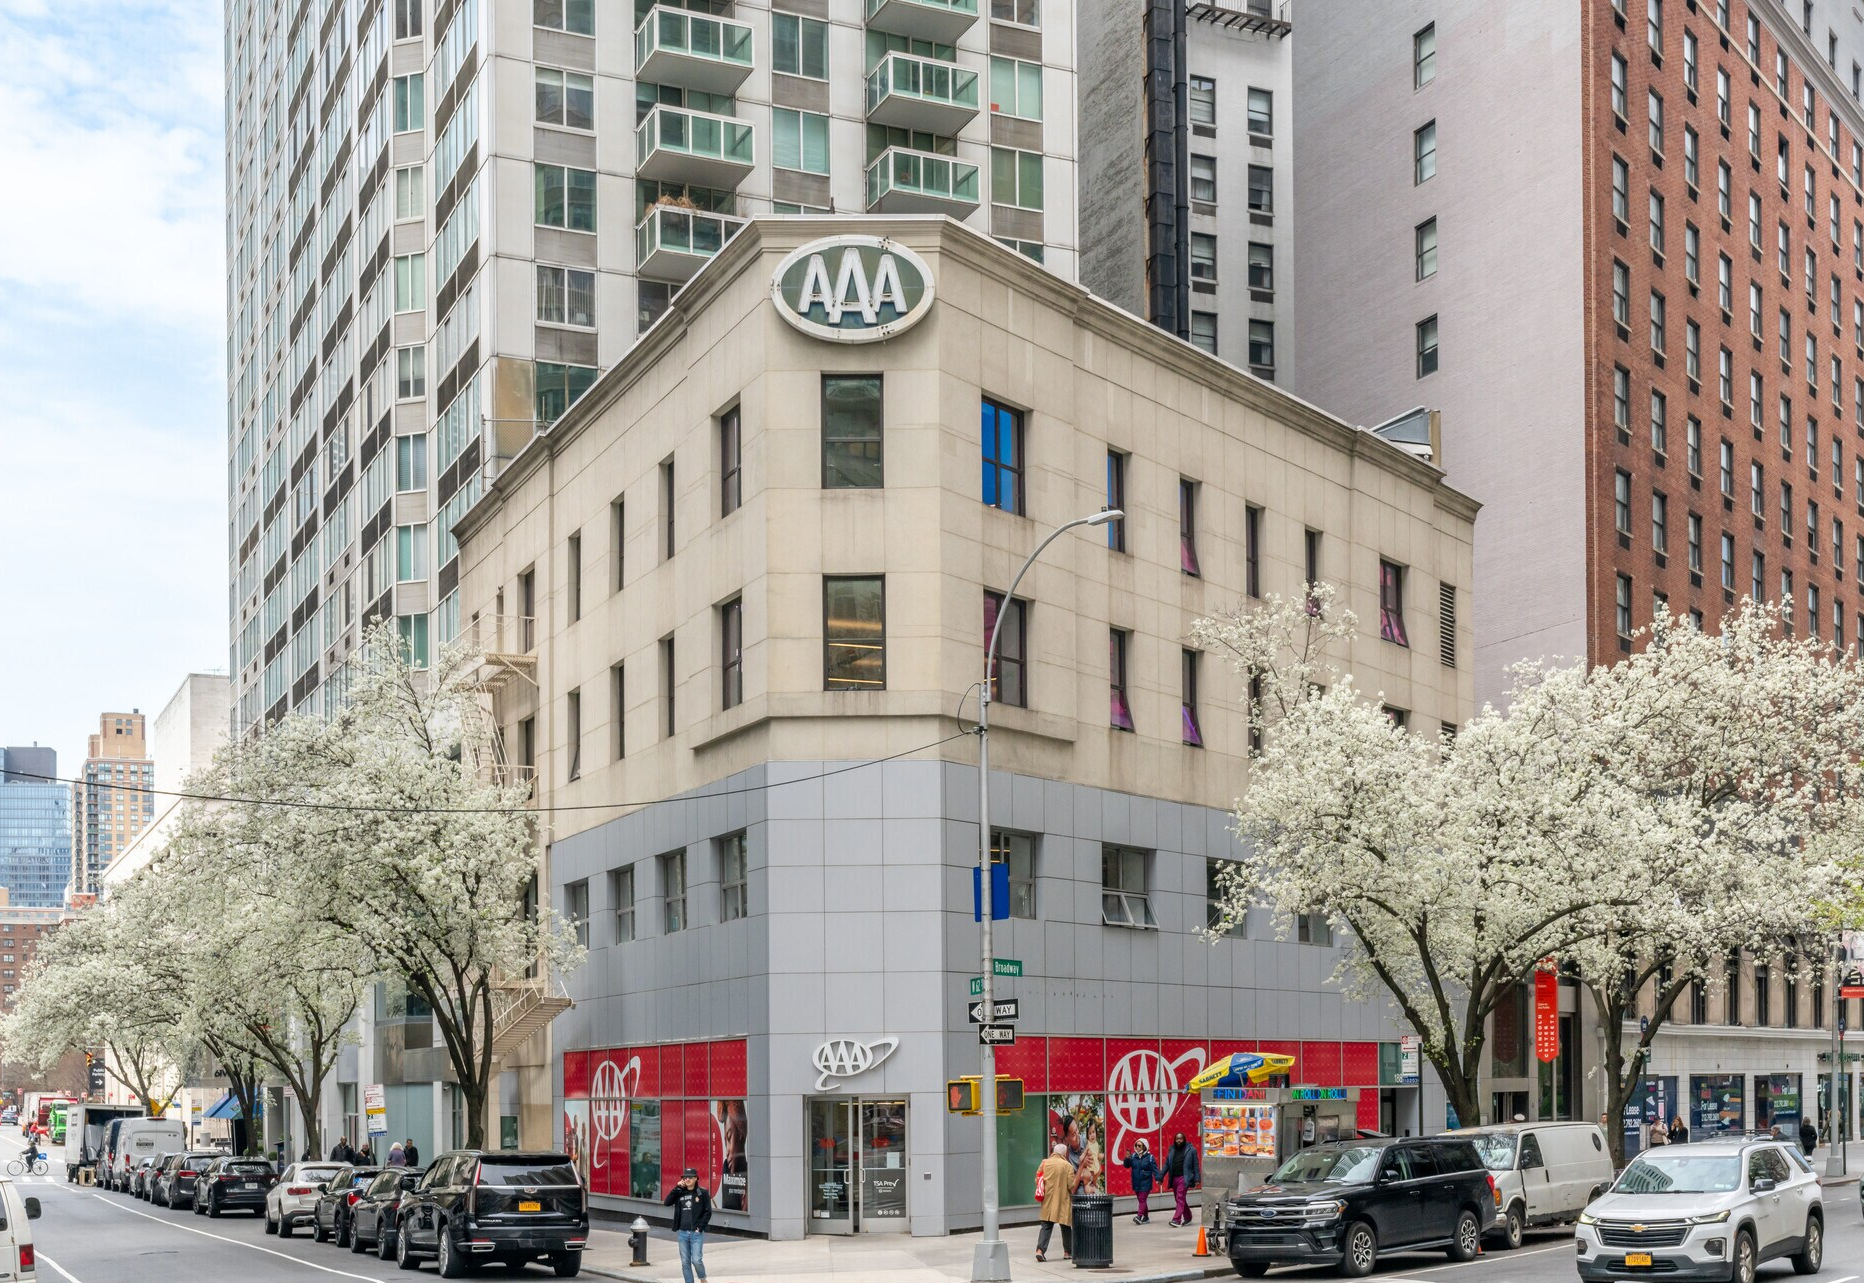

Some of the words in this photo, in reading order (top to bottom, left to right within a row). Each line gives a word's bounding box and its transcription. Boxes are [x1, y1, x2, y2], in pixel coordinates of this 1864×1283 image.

[798, 247, 908, 324] AAA
[995, 961, 1019, 976] Broadway
[996, 1005, 1012, 1015] WAY
[984, 1030, 995, 1039] ONE
[1000, 1030, 1011, 1039] WAY
[817, 1040, 869, 1075] AAA
[1199, 1072, 1222, 1084] SABRETT
[1708, 1101, 1718, 1110] Lease
[723, 1173, 747, 1186] Maximize
